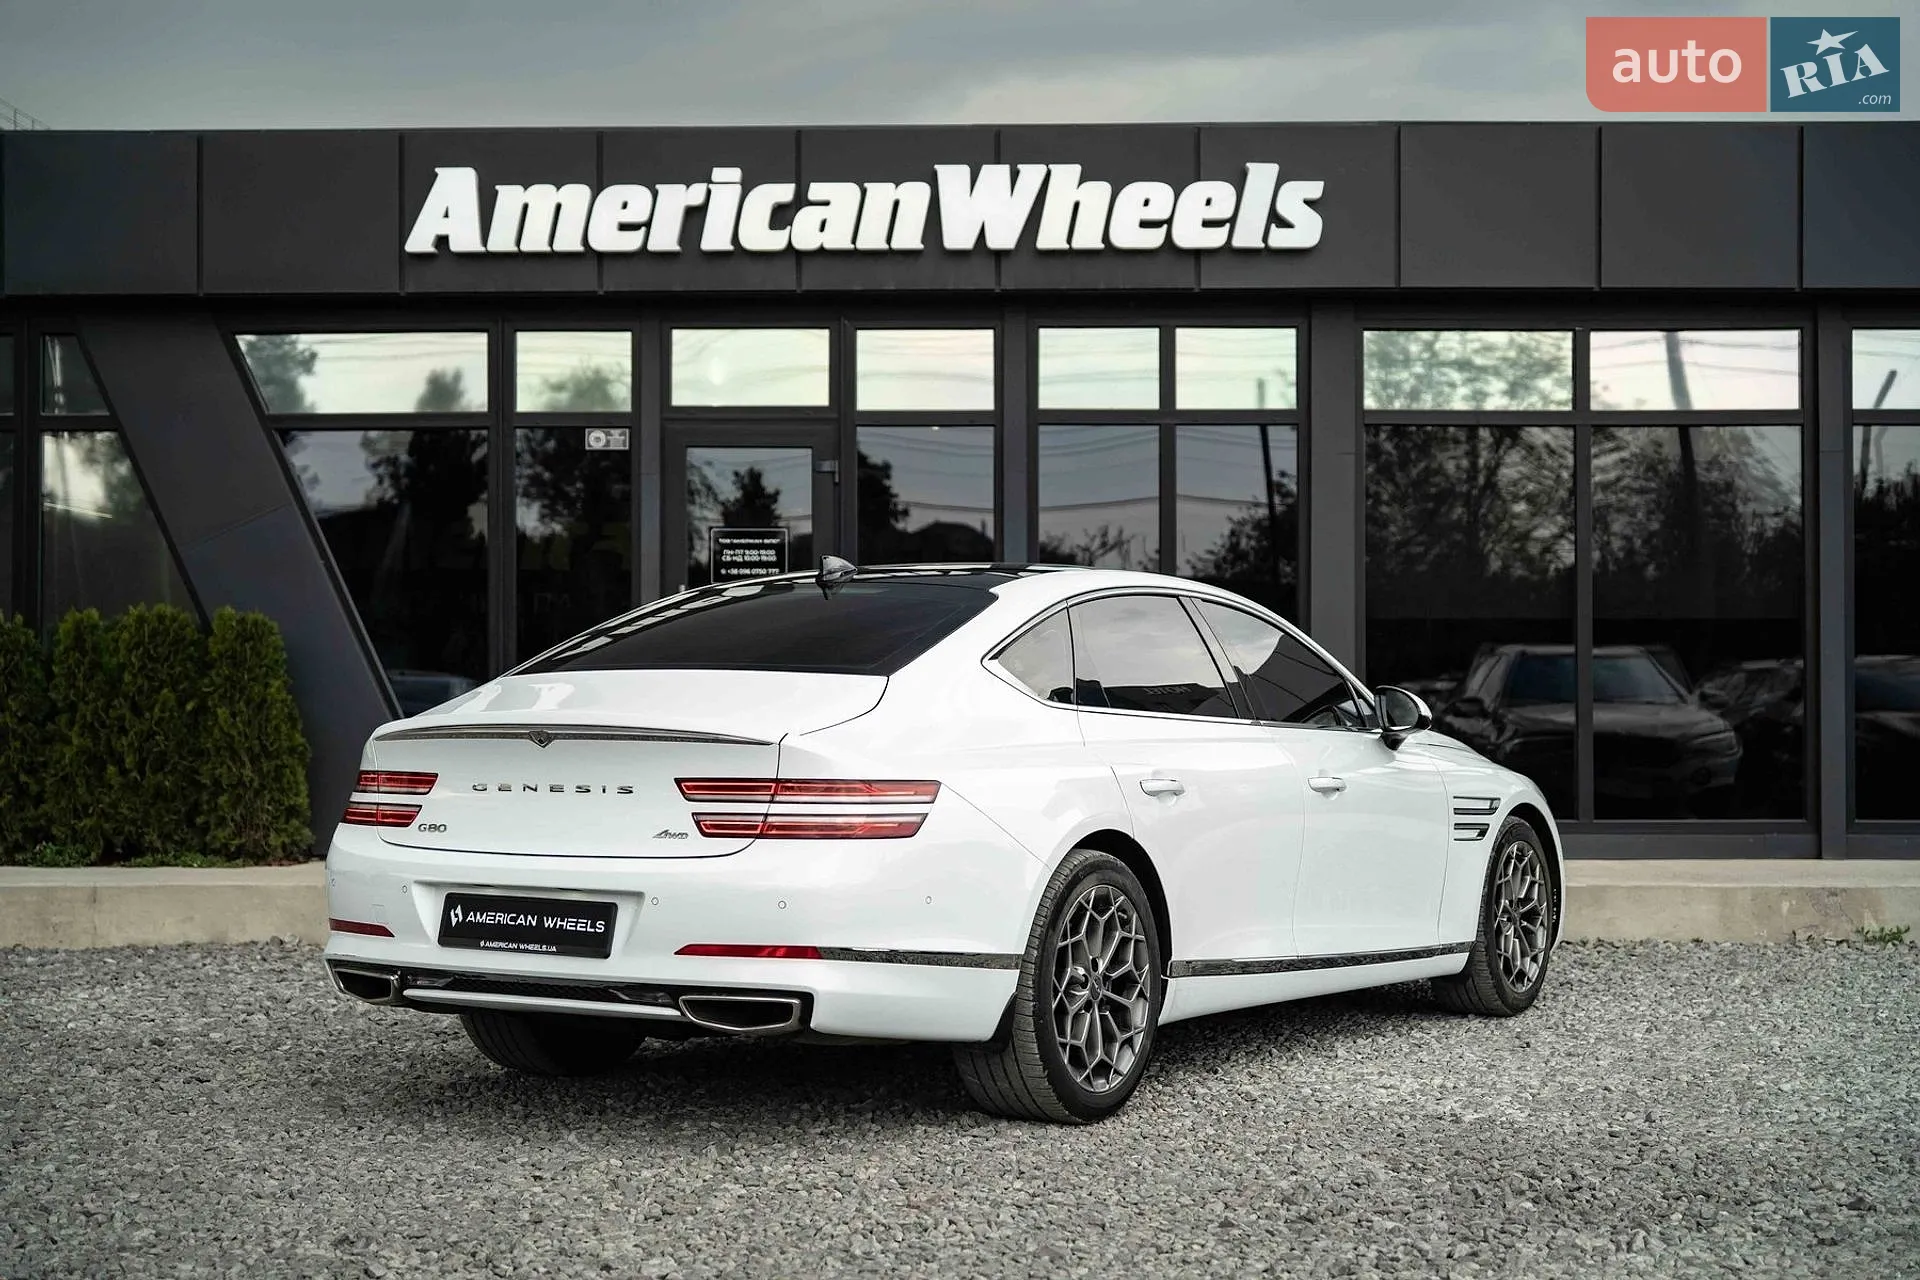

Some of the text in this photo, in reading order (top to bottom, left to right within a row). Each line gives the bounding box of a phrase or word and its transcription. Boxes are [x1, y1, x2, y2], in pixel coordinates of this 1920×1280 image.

[404, 163, 1325, 253] AmericanWheels
[471, 783, 634, 795] GENESIS
[417, 823, 447, 833] G80
[466, 911, 606, 933] AMERICAN WHEELS
[485, 941, 518, 949] AMERICAN
